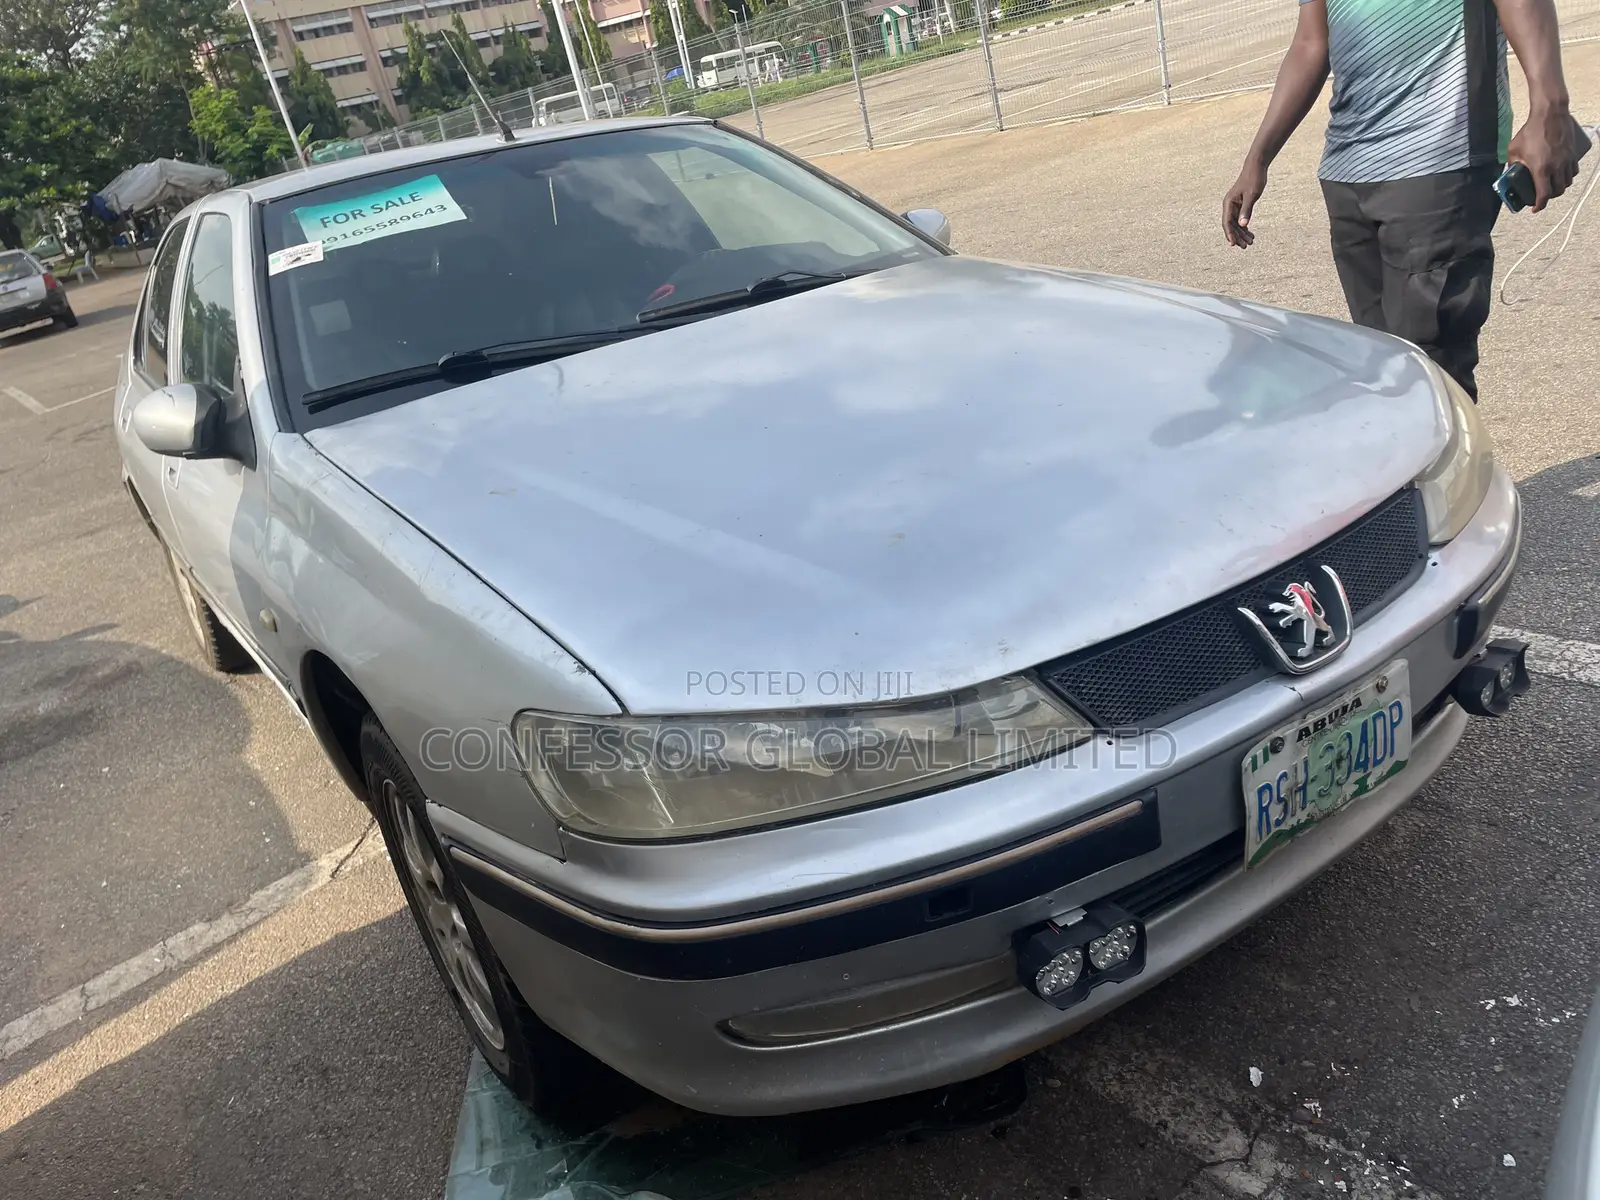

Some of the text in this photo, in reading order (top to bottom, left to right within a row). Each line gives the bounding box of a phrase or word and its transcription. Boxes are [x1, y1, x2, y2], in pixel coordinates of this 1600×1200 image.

[319, 191, 424, 229] FOR SALE
[1296, 696, 1363, 743] ABUJA
[1255, 699, 1404, 842] RSH-334DP
